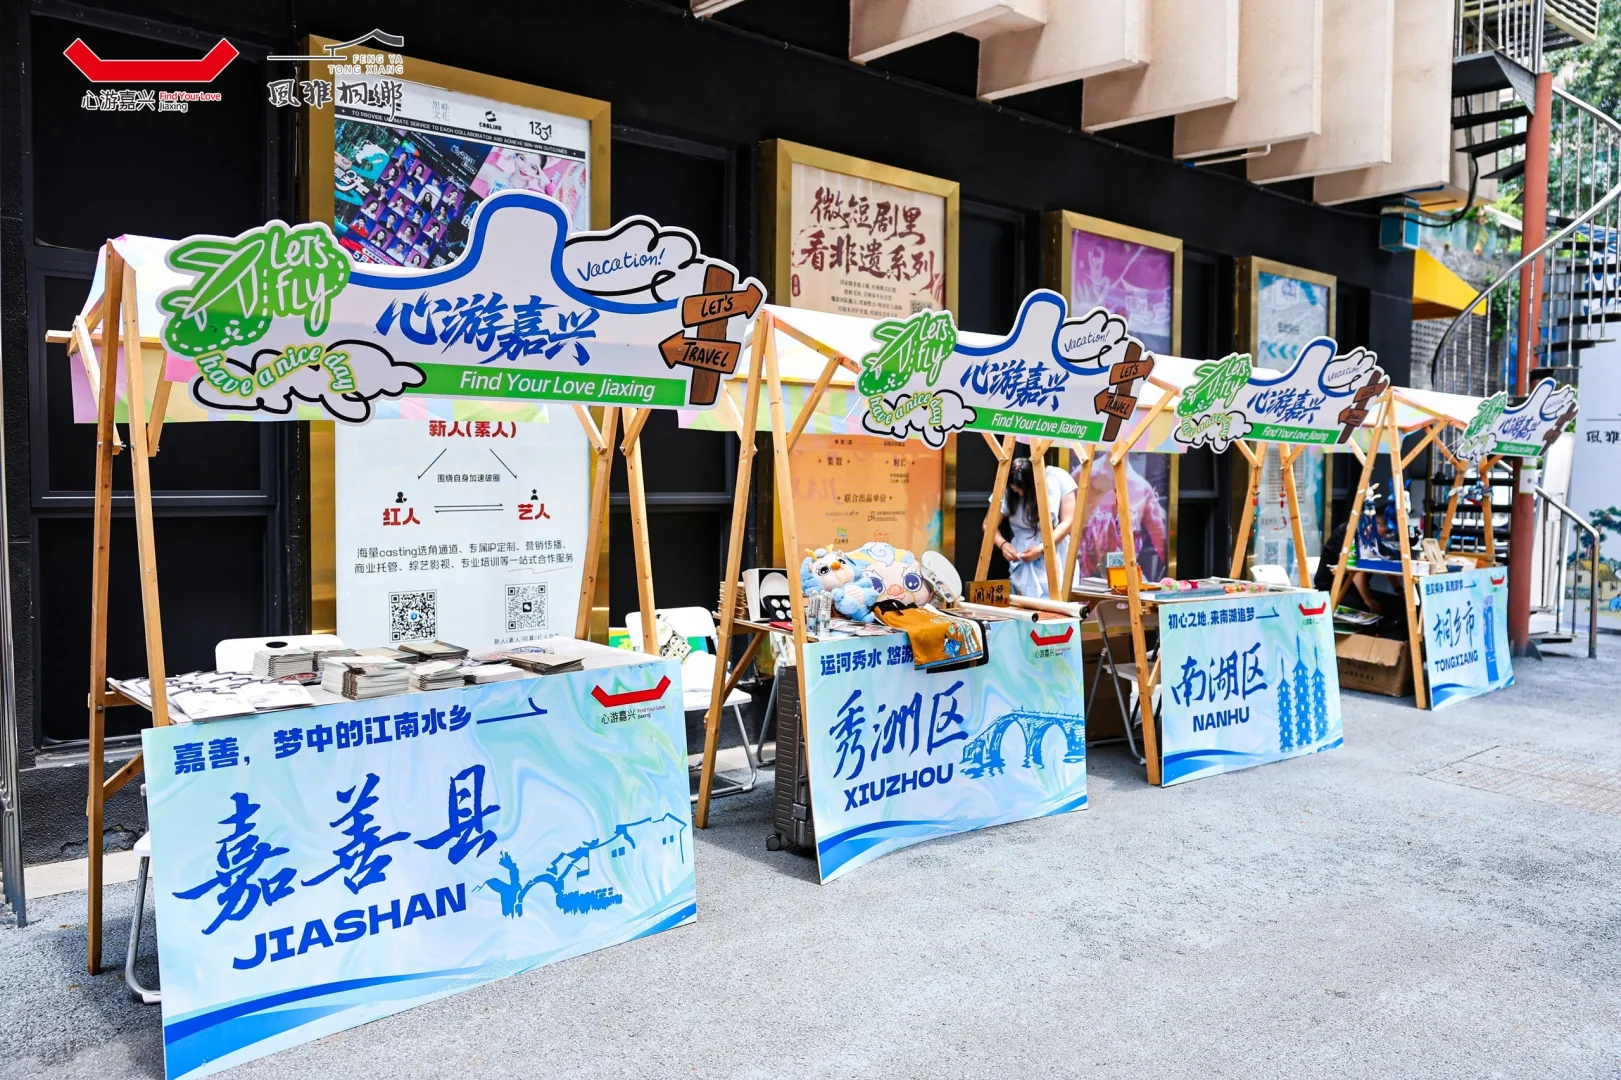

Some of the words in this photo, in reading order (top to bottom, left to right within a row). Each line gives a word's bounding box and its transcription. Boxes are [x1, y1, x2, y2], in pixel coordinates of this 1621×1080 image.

[360, 111, 382, 121] PROVIDE
[410, 119, 430, 130] SERVICE
[432, 123, 439, 131] TO
[439, 125, 454, 134] EACH
[454, 128, 493, 141] COLLABORATOR
[494, 135, 503, 143] AND
[800, 230, 936, 291] 看非遗系列
[701, 297, 734, 318] LET'S
[375, 291, 601, 366] 心游嘉兴
[198, 353, 252, 395] have
[257, 367, 274, 388] a
[277, 346, 320, 375] nice
[324, 353, 354, 391] day
[460, 370, 503, 391] Find
[507, 373, 551, 393] Your
[554, 375, 596, 396] Love
[598, 378, 655, 402] Jiaxing
[960, 358, 1070, 411] 心游嘉兴
[1247, 388, 1326, 425] 心游嘉兴
[991, 413, 1012, 427] Find
[1014, 416, 1037, 430] Your
[1037, 418, 1057, 433] Love
[1057, 420, 1087, 438] Jiaxing
[1262, 426, 1277, 436] Find
[1278, 428, 1293, 439] Your
[437, 474, 501, 483] 围绕自身加速破圈
[383, 507, 420, 526] 红人
[518, 503, 550, 521] 艺人
[1433, 600, 1476, 648] 桐乡市
[820, 649, 882, 676] 运河秀水
[1170, 642, 1268, 708] 南湖区
[1434, 650, 1479, 673] TONGXIANG
[601, 709, 636, 724] 心游嘉兴
[829, 680, 969, 781] 秀洲区
[1193, 706, 1250, 732] NANHU
[844, 763, 954, 812] XIUZHOU
[173, 763, 501, 935] 嘉善县
[233, 882, 467, 969] JIASHAN
